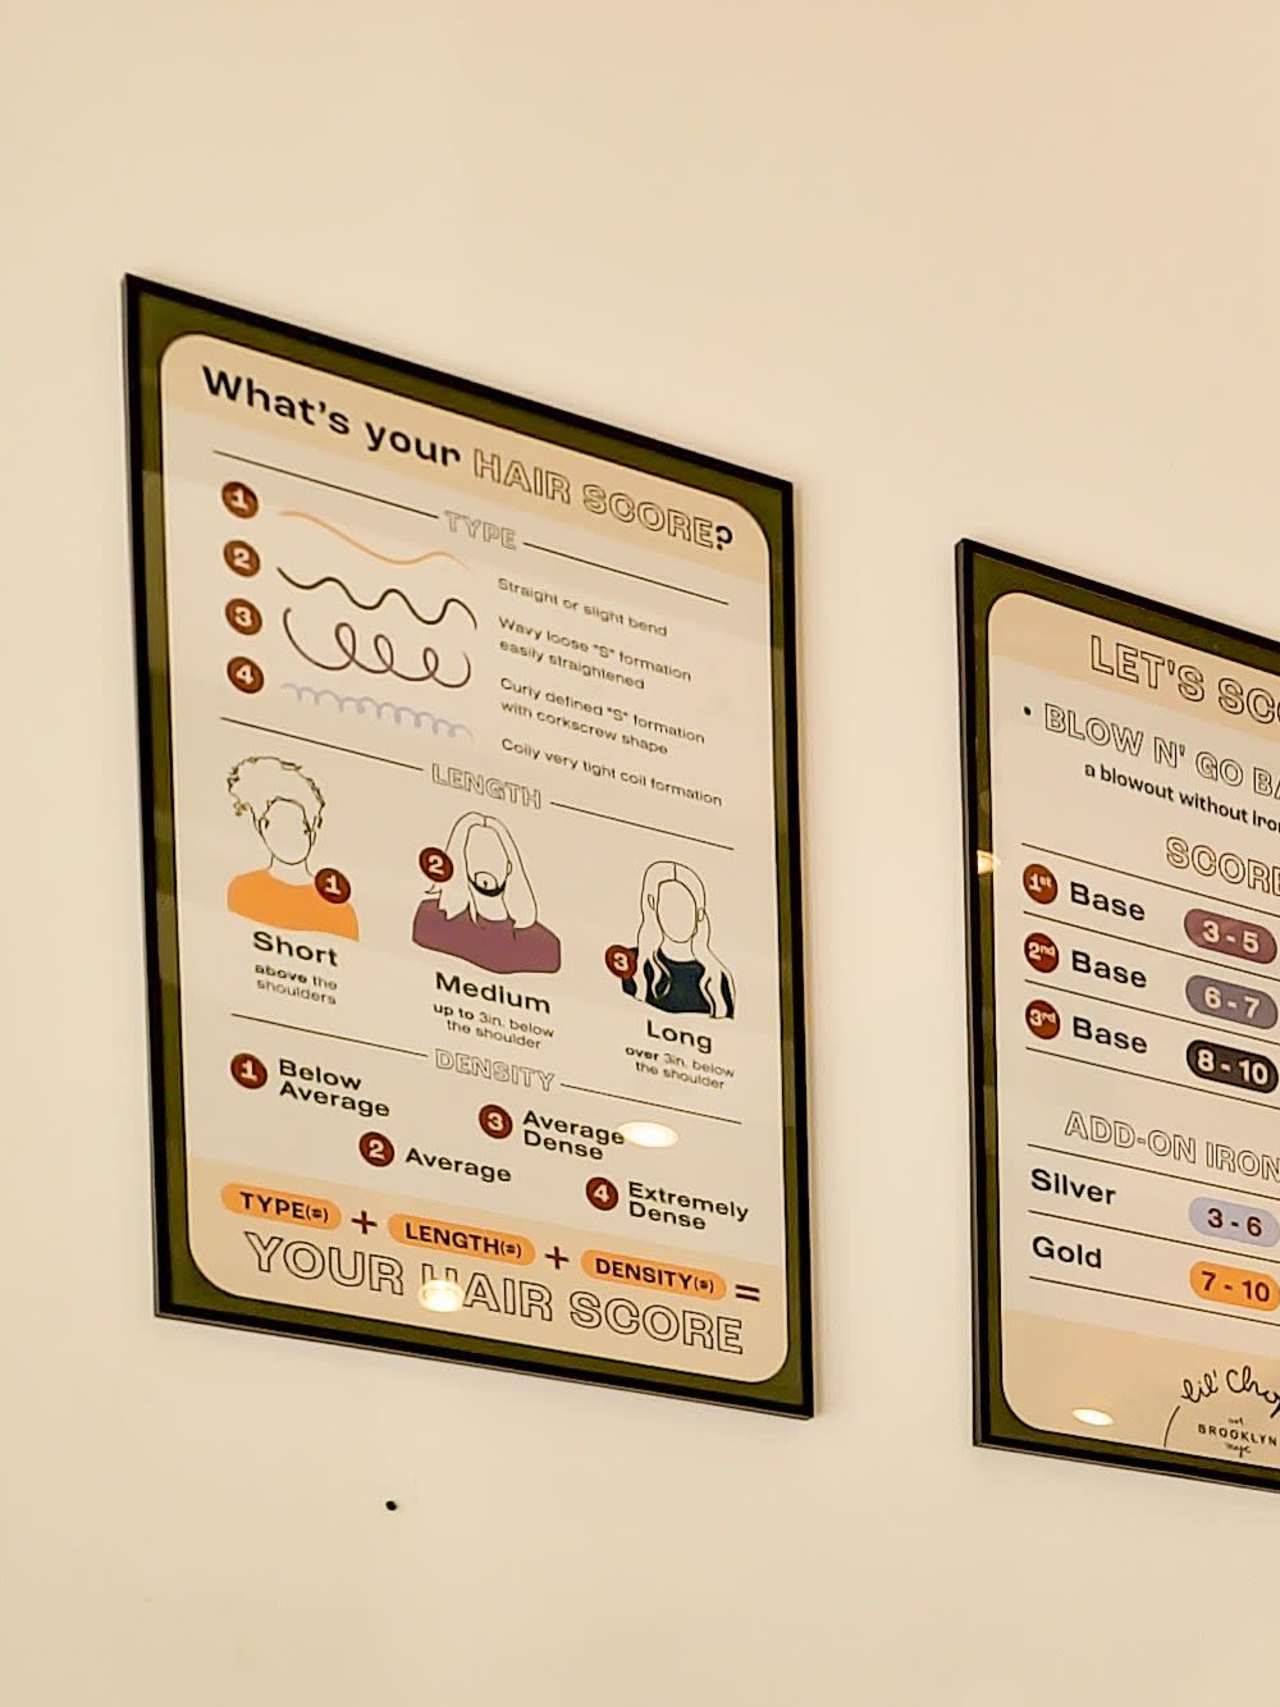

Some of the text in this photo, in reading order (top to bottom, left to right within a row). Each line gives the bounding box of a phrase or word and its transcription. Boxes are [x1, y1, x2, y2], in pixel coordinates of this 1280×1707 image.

[201, 365, 732, 550] What's your HAIR SCORE?
[233, 488, 249, 510] 1
[445, 510, 517, 551] TYPE
[233, 547, 250, 569] 2
[235, 606, 251, 626] 3
[498, 578, 668, 637] Straight or slight bend
[498, 616, 692, 682] Wavy loose "S" formation
[499, 639, 645, 689] easily straightened
[236, 664, 254, 685] 4
[1091, 634, 1205, 702] LET'S
[501, 677, 705, 744] Curly defined "S" formation
[501, 701, 668, 755] with corkscrew shape
[1044, 702, 1144, 757] BLOW
[1154, 737, 1185, 769] N'
[1195, 751, 1244, 787] GO
[432, 762, 541, 809] LENGTH
[502, 738, 722, 807] Coily very tight coil formation
[1085, 764, 1096, 778] a
[1100, 764, 1174, 803] blowout
[1179, 789, 1248, 825] without
[428, 855, 445, 875] 2
[1028, 872, 1053, 893] 1st
[324, 874, 341, 895] 1
[1070, 881, 1146, 922] Base
[253, 930, 338, 967] Short
[613, 952, 628, 971] 3
[1028, 941, 1056, 961] 2nd
[255, 965, 337, 991] above the
[1071, 950, 1147, 988] Base
[256, 978, 337, 1005] shoulders
[435, 971, 551, 1014] Medium
[433, 1003, 554, 1038] up to 3in. below
[446, 1020, 541, 1049] the shoulder
[1029, 1008, 1056, 1027] 3rd
[1072, 1016, 1148, 1054] Base
[646, 1019, 712, 1055] Long
[241, 1060, 257, 1081] 1
[279, 1058, 361, 1091] Below
[435, 1048, 555, 1092] DENSITY
[625, 1045, 735, 1078] over 3in. below
[635, 1060, 725, 1090] the shoulder
[279, 1080, 390, 1118] Average
[488, 1112, 503, 1131] 3
[523, 1110, 625, 1145] Average
[1065, 1110, 1196, 1163] ADD-ON
[368, 1139, 385, 1160] 2
[524, 1129, 604, 1160] Dense
[405, 1148, 512, 1183] Average
[594, 1183, 610, 1203] 4
[629, 1181, 749, 1222] Extremely
[1031, 1167, 1116, 1206] Silver
[629, 1201, 706, 1231] Dense
[1032, 1236, 1102, 1269] Gold
[244, 1230, 404, 1296] YOUR
[570, 1290, 743, 1354] SCORE
[1198, 1423, 1277, 1447] BROOKLYN
